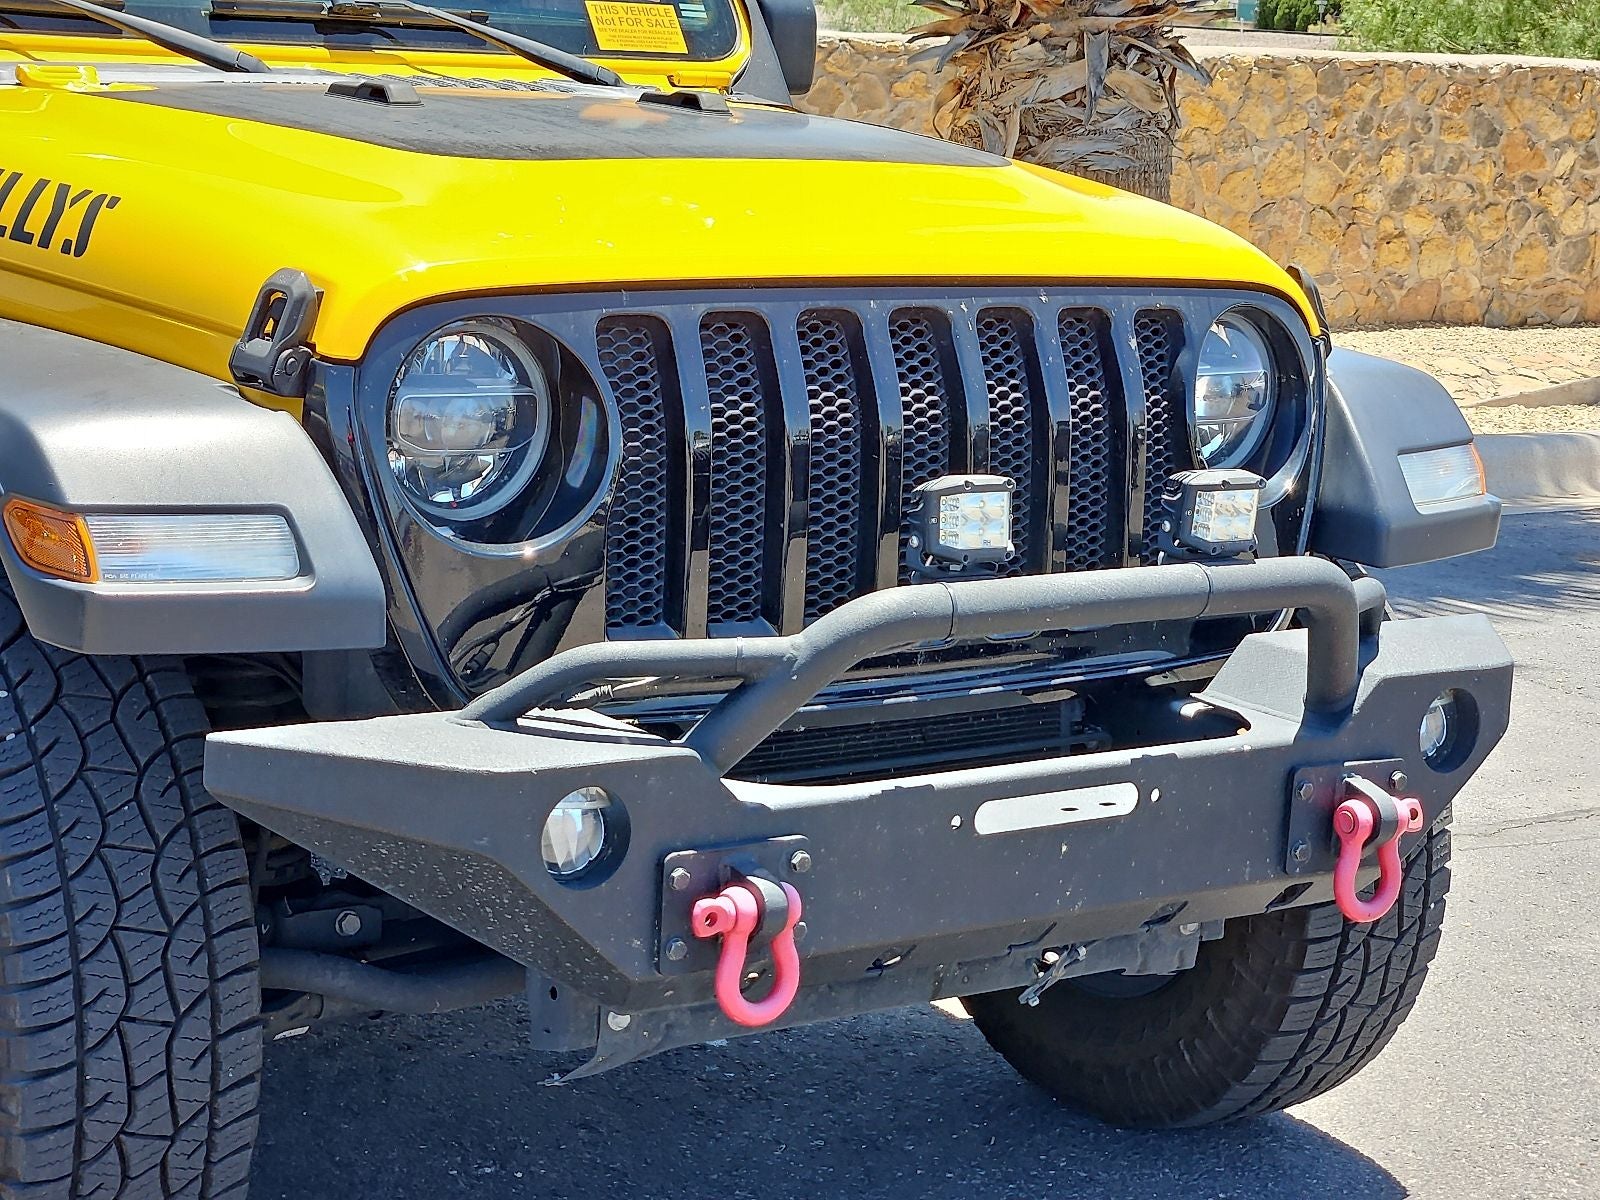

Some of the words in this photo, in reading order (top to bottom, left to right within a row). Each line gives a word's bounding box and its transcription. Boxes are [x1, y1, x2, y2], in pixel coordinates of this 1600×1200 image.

[591, 4, 619, 15] THIS
[620, 6, 673, 18] VEHICLE
[595, 16, 617, 26] Not
[618, 17, 643, 27] FOR
[645, 18, 678, 29] SALE
[0, 168, 122, 258] LLYS
